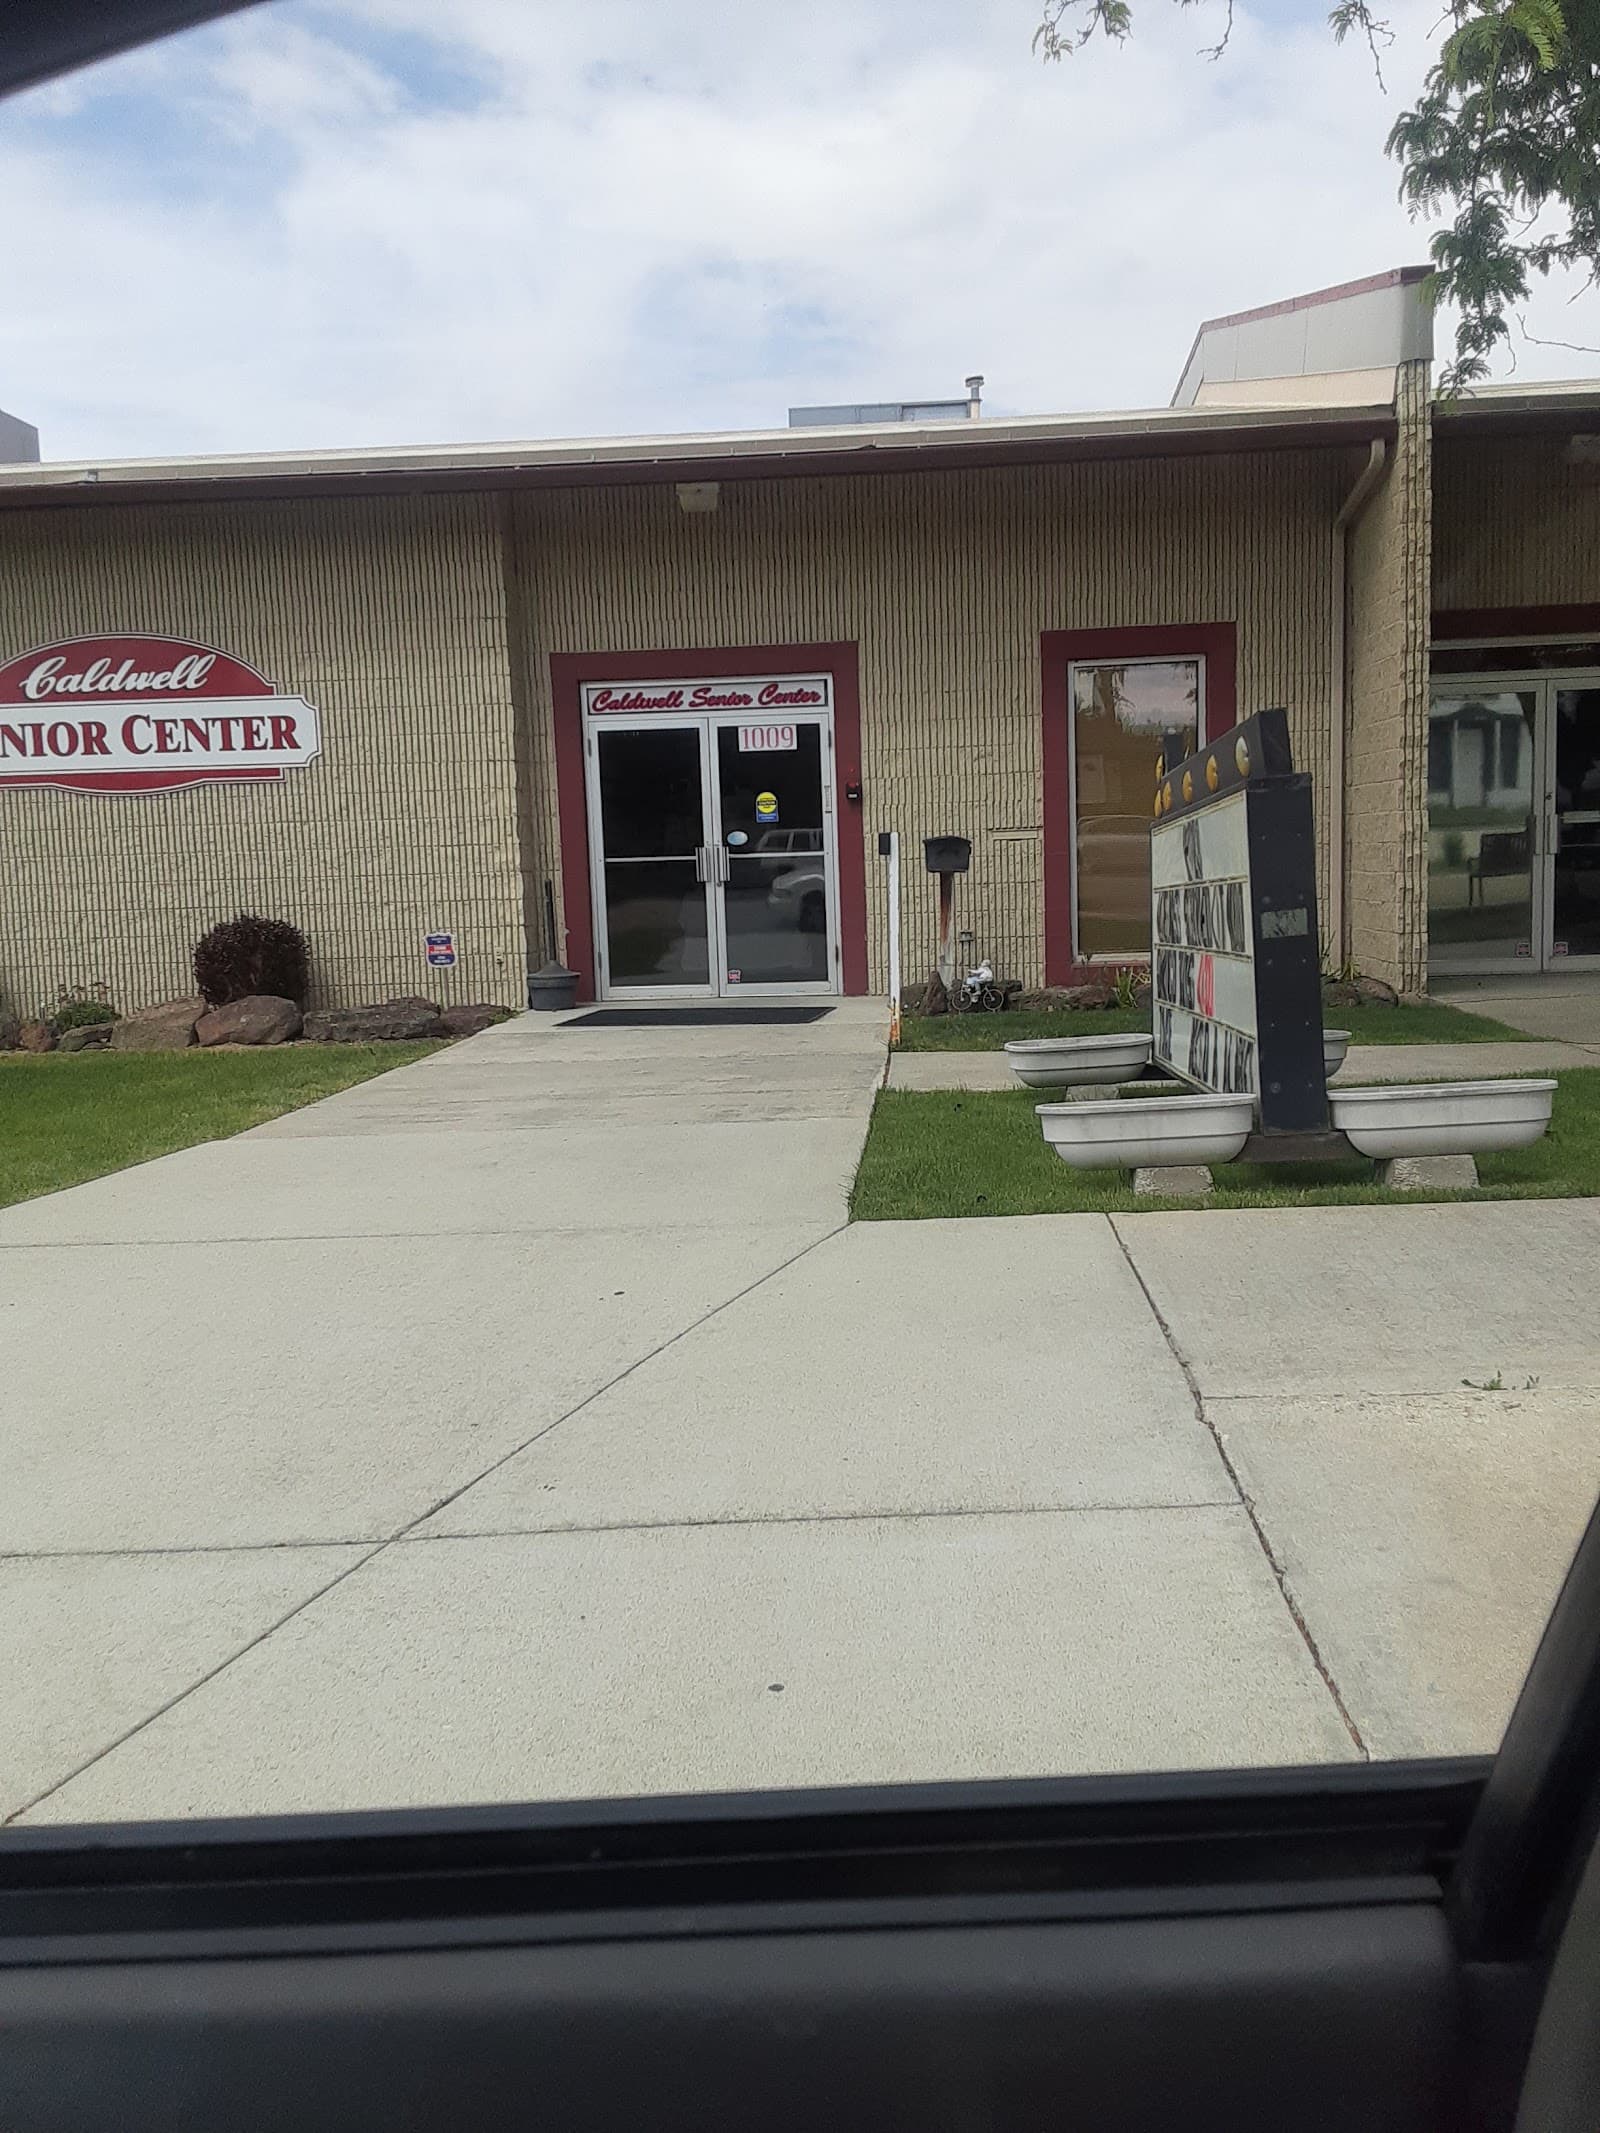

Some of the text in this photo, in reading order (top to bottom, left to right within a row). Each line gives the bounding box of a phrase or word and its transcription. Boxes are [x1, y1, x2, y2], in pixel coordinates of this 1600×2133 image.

[19, 654, 216, 700] Caldwell
[591, 683, 821, 712] Caldwell Senior Center
[121, 714, 302, 755] CENTER
[741, 726, 795, 750] 1009
